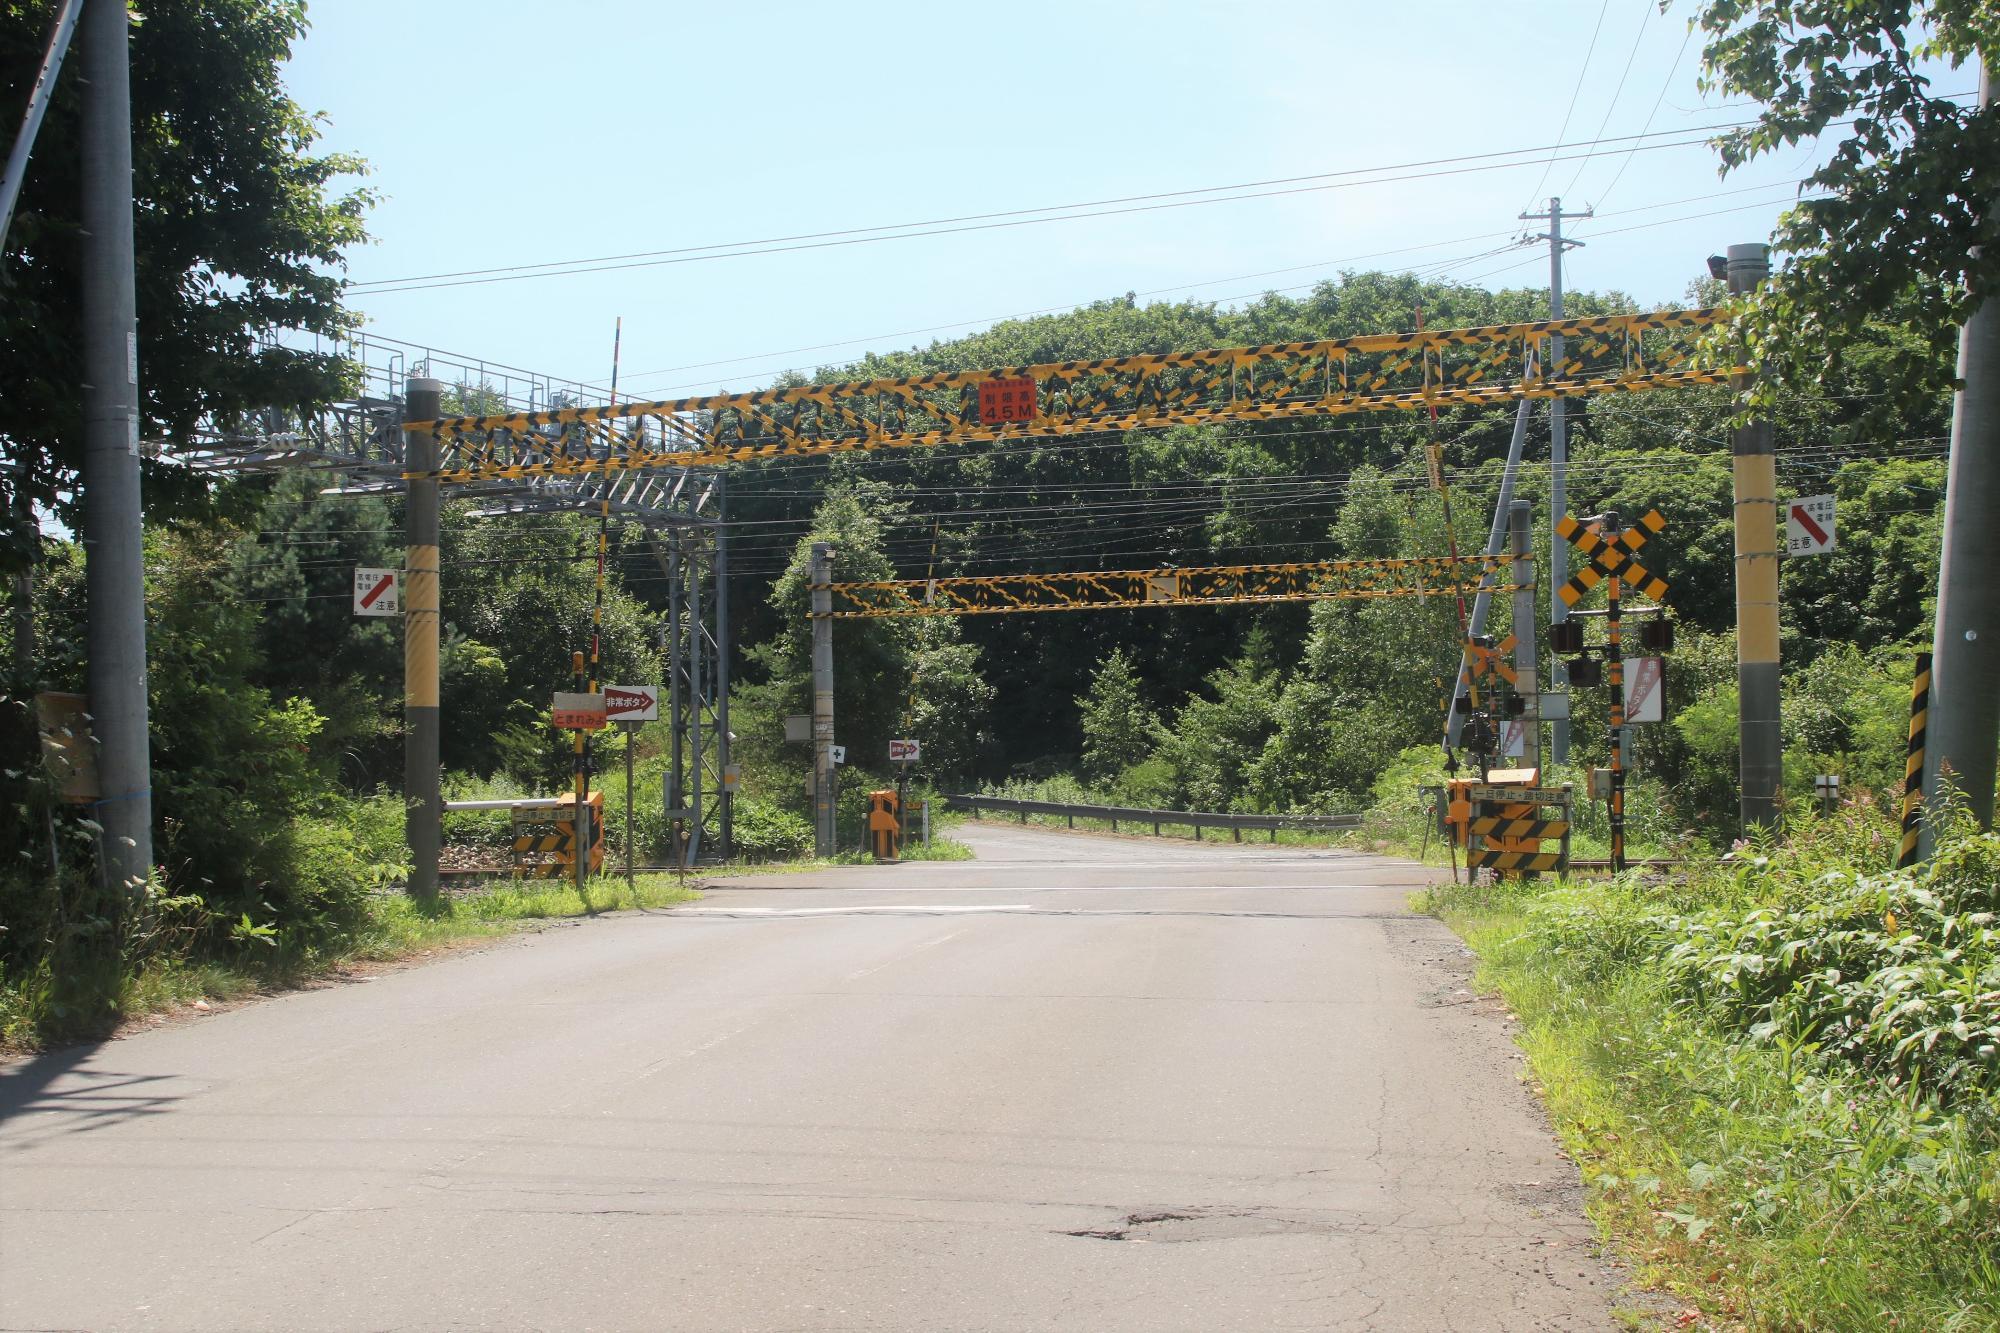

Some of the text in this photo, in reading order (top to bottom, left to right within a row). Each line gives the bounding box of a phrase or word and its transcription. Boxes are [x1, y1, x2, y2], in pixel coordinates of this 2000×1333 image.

[1808, 500, 1833, 512] 高電圧
[1817, 513, 1833, 522] 電線
[1790, 536, 1811, 550] 注意
[376, 600, 396, 611] 注意
[1627, 660, 1657, 715] 非常ボタン
[606, 697, 649, 708] 非常ボタン
[555, 714, 604, 726] とまれみよ
